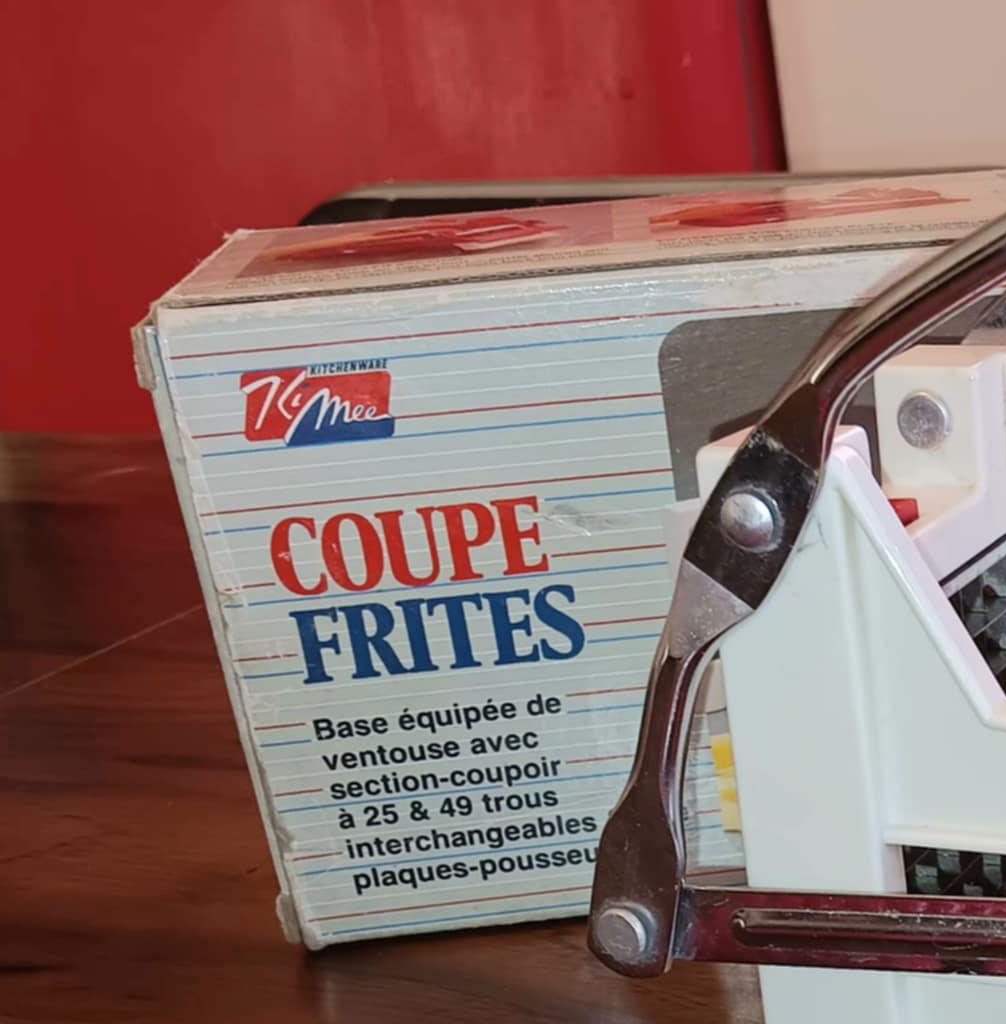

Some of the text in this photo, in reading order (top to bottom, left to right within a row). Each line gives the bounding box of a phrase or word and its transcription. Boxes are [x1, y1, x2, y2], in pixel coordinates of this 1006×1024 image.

[270, 495, 549, 596] COUPE
[289, 584, 585, 684] FRITES
[313, 693, 562, 741] Base équipée de
[322, 731, 539, 771] ventouse avec
[330, 756, 561, 800] section-coupoir
[339, 790, 559, 830] à 25 & 49 trous
[346, 814, 598, 860] interchangeables
